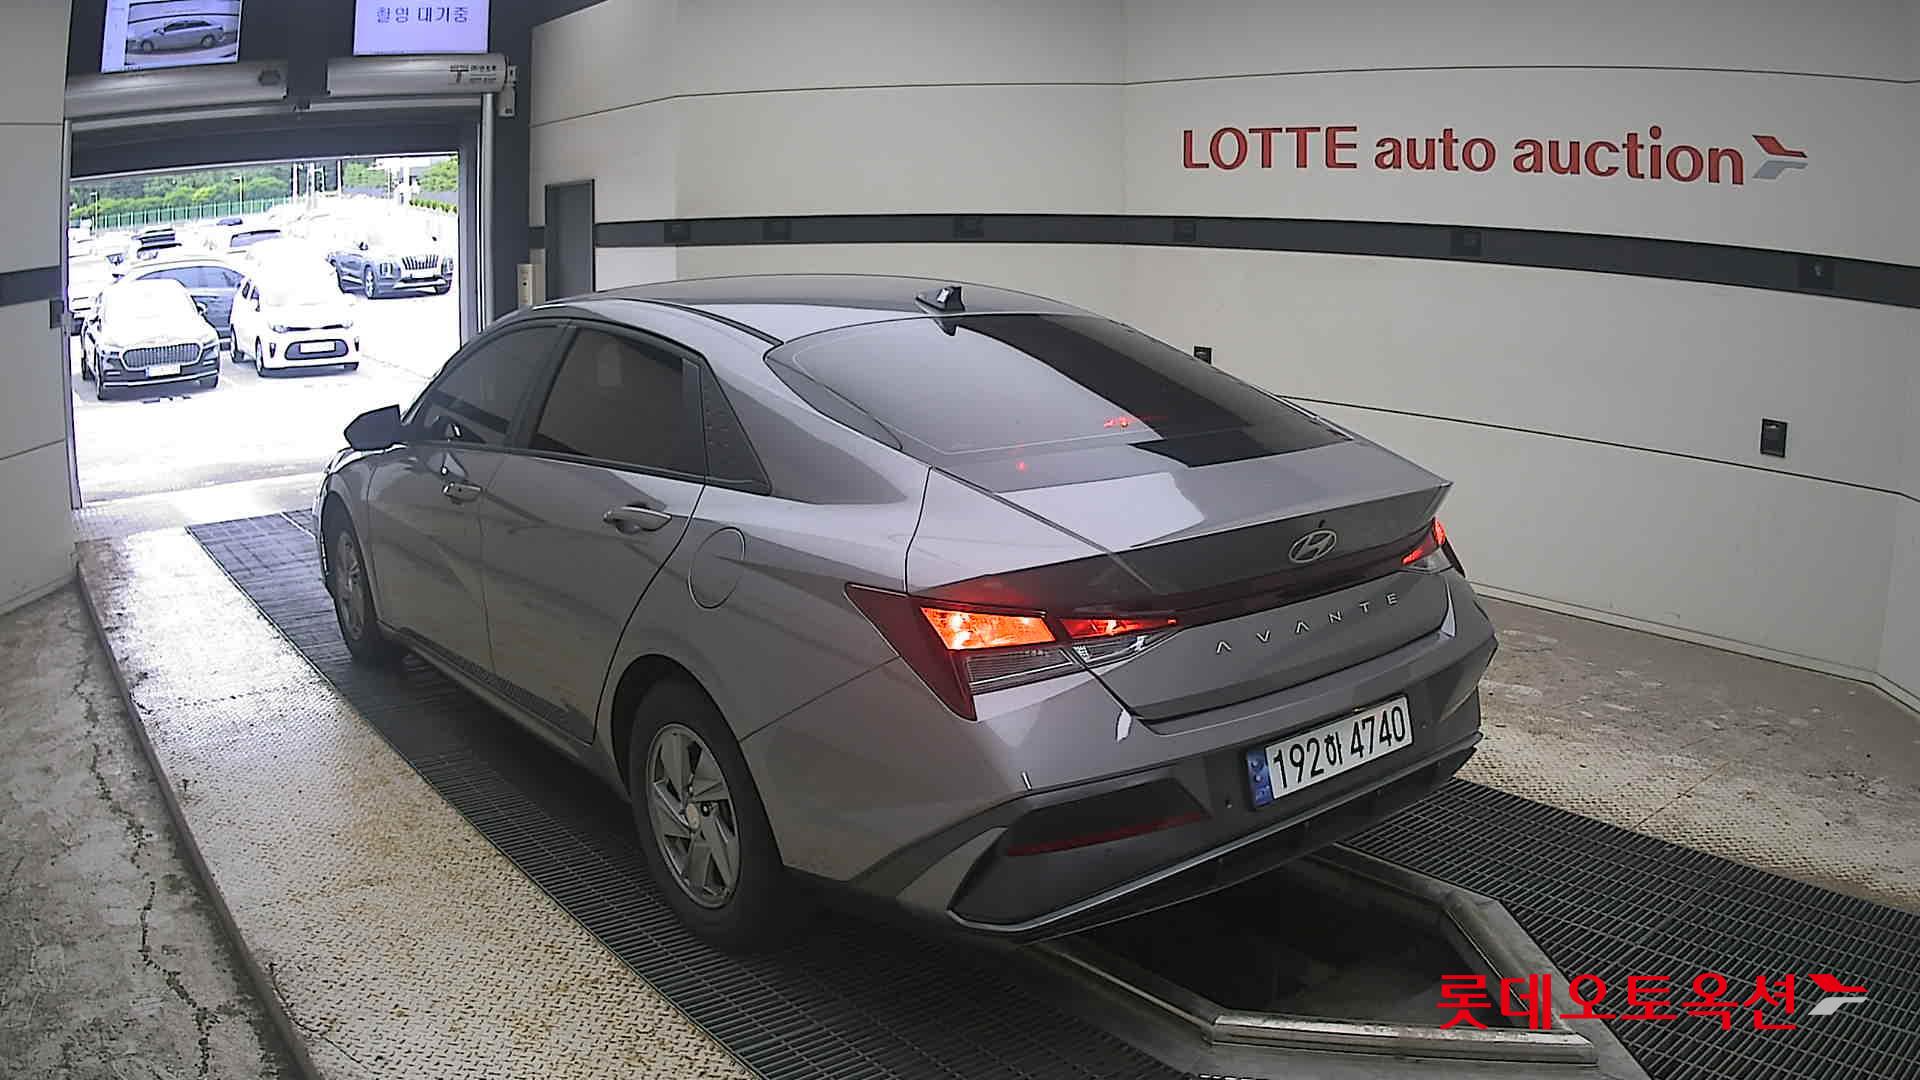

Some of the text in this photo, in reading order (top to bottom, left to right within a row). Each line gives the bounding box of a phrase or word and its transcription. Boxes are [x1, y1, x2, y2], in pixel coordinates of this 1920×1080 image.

[417, 7, 468, 23] 대기중
[1183, 126, 1745, 185] LOTTE auto auction
[1216, 593, 1398, 654] AVANTE
[1273, 706, 1406, 788] 192하 4740
